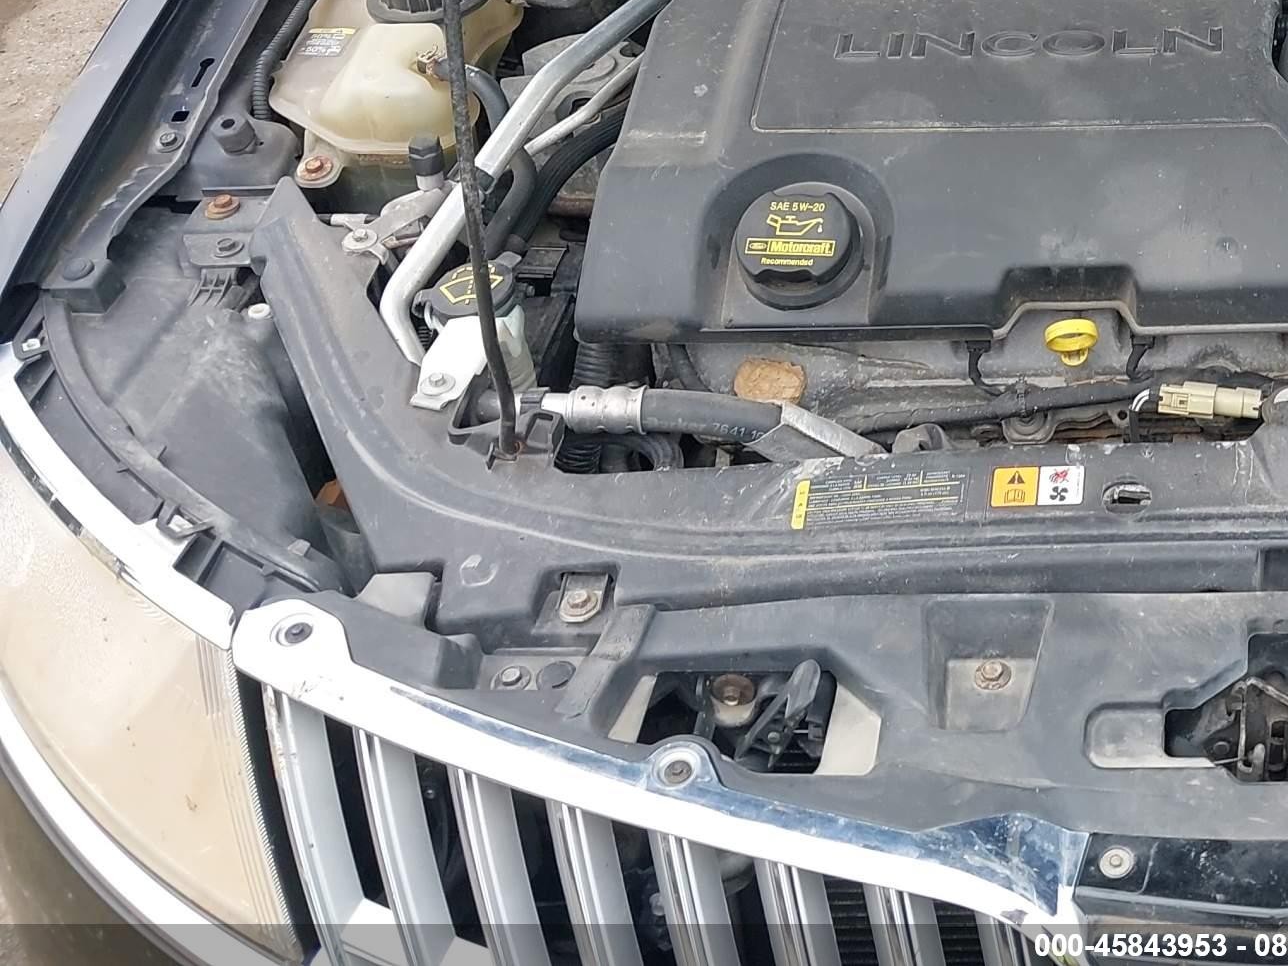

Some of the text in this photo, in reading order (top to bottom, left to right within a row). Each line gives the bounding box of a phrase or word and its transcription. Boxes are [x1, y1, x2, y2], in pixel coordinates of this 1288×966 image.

[833, 26, 1225, 60] LINCOLN
[769, 201, 826, 213] SAE 5W-20
[760, 257, 814, 267] Recommended
[711, 422, 746, 437] 7641
